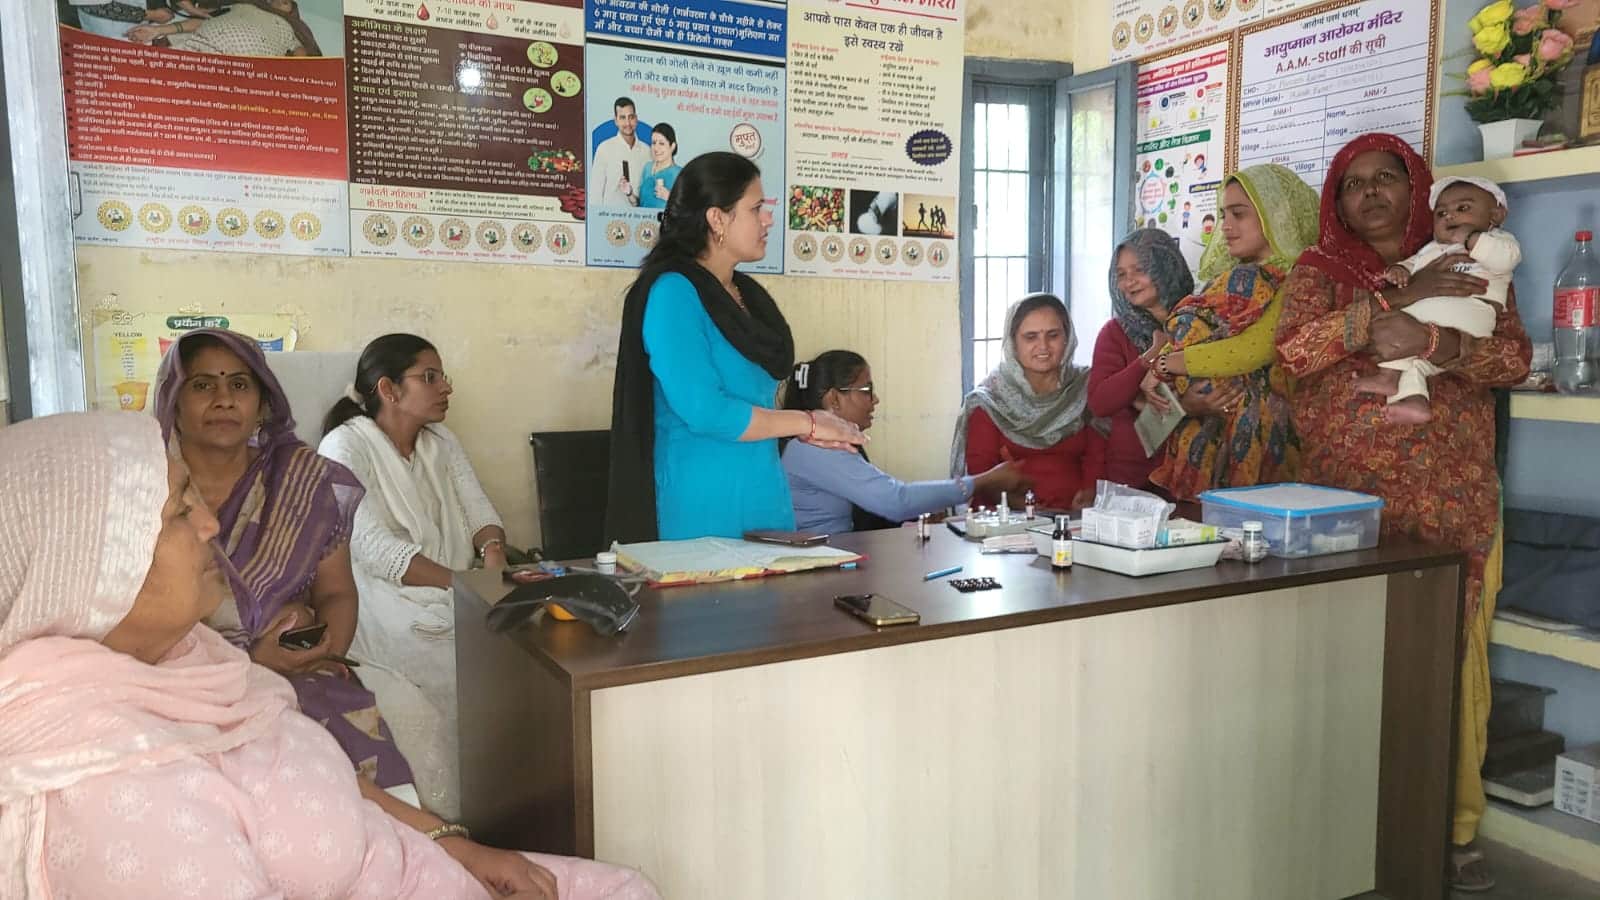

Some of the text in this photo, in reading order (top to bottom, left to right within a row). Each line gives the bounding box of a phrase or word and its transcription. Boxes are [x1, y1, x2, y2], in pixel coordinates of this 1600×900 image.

[594, 8, 599, 16] 6
[602, 9, 616, 19] माह
[676, 19, 689, 29] माह
[768, 32, 779, 41] मत
[638, 0, 647, 11] की
[650, 2, 669, 14] गोली
[709, 11, 716, 21] के
[757, 18, 764, 28] से
[766, 19, 782, 30] लेकर
[804, 9, 942, 40] आपके पास केवल एक ही जीवन है
[351, 18, 390, 31] अनीमिया
[394, 23, 402, 33] के
[607, 21, 621, 32] और
[665, 29, 673, 39] को
[677, 30, 683, 40] ही
[686, 32, 710, 44] मिलेगी
[1264, 9, 1404, 58] आयुष्मान आरोग्य मंदिर
[844, 34, 858, 47] इसे
[861, 38, 885, 50] स्वस्थ
[1349, 40, 1362, 55] की
[1366, 35, 1386, 54] सूची
[624, 53, 653, 65] आयरन
[656, 57, 666, 67] की
[670, 58, 689, 69] गोली
[691, 61, 704, 71] लेने
[706, 62, 713, 72] से
[733, 66, 743, 76] की
[745, 67, 760, 78] कमी
[624, 69, 641, 80] होती
[644, 72, 659, 82] और
[680, 76, 688, 85] के
[746, 83, 770, 95] मिलती
[772, 86, 777, 95] है
[1363, 86, 1387, 98] ANM-2
[378, 87, 389, 96] एवं
[393, 88, 417, 98] इलाज
[1327, 110, 1346, 119] Name
[1241, 127, 1258, 135] Name
[174, 317, 222, 329] प्रयोग करें
